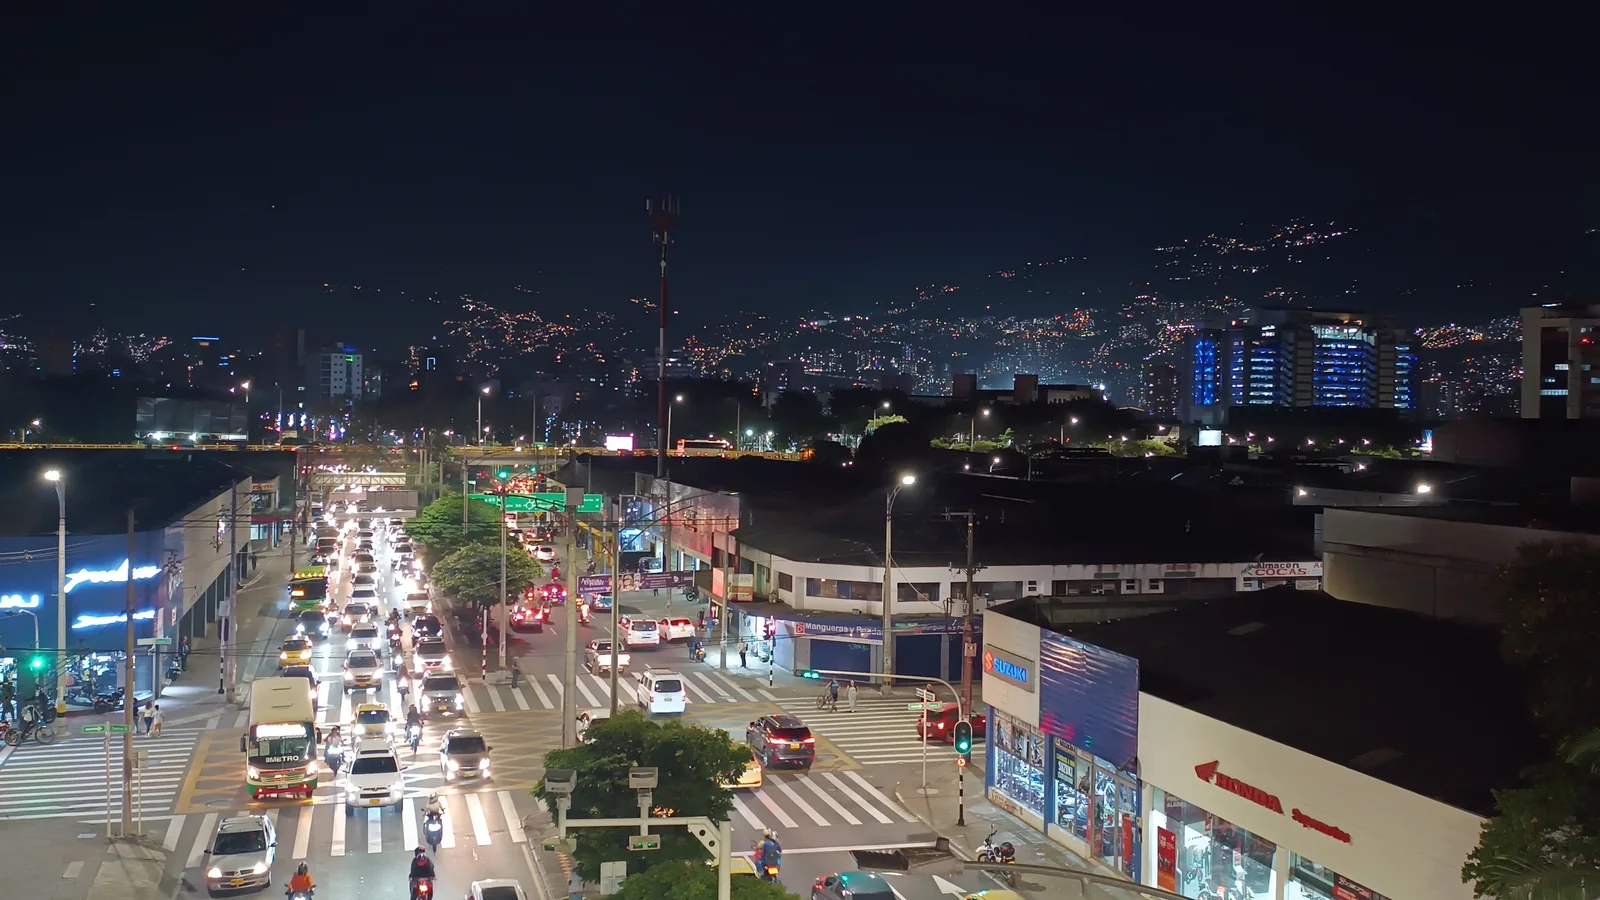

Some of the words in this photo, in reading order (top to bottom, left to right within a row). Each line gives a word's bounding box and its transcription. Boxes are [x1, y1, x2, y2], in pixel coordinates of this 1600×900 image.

[1255, 568, 1307, 576] COCAS
[805, 622, 848, 634] Mangueras
[849, 626, 855, 635] y
[994, 657, 1027, 682] SUZUKI
[1215, 772, 1285, 815] HONDA
